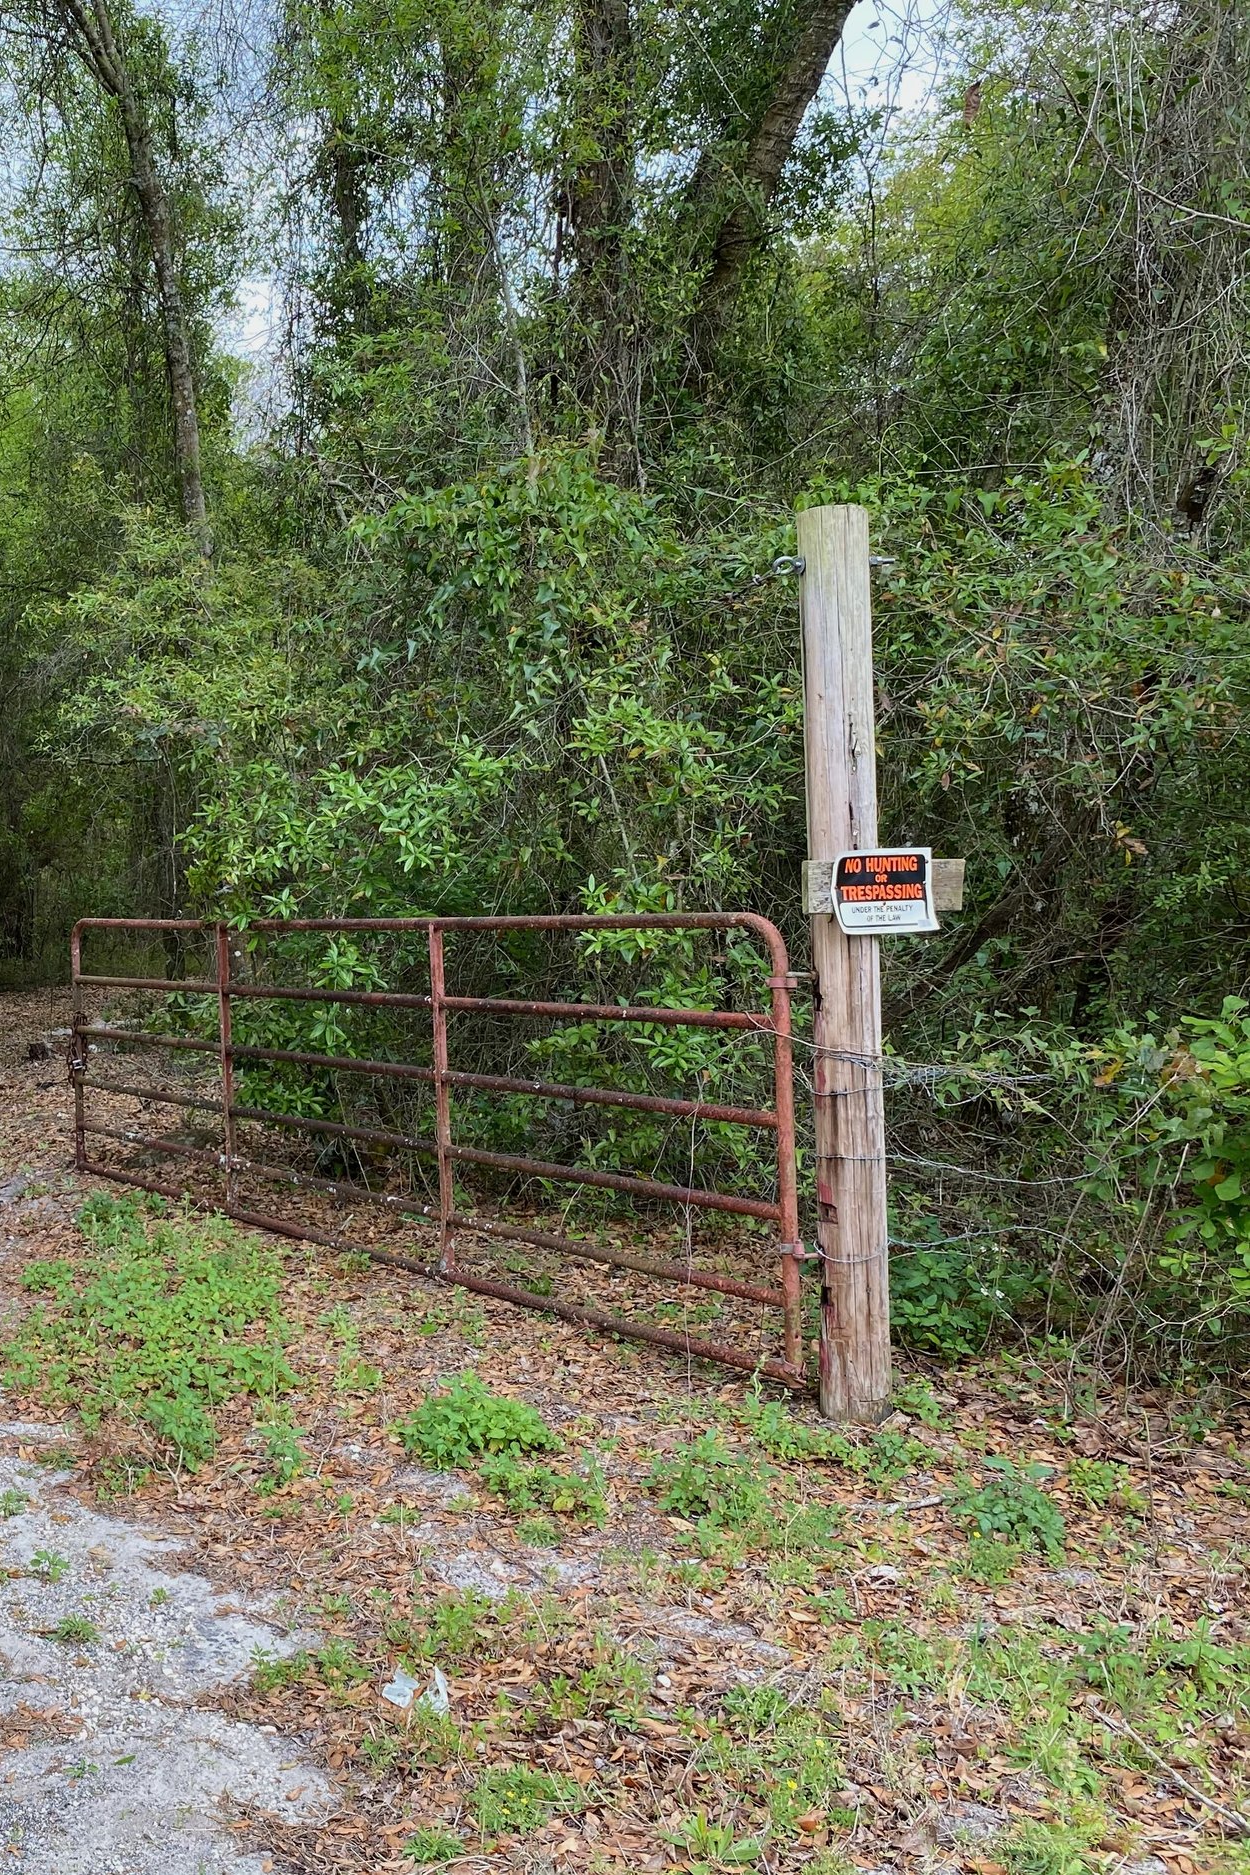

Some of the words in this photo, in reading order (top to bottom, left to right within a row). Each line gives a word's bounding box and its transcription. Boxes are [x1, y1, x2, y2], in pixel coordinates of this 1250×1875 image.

[845, 858, 862, 873] NO
[866, 856, 918, 873] HUNTING
[875, 874, 888, 882] OR
[840, 883, 923, 901] TRESPASSING
[852, 906, 871, 914] UNDER
[886, 905, 913, 913] PENALTY
